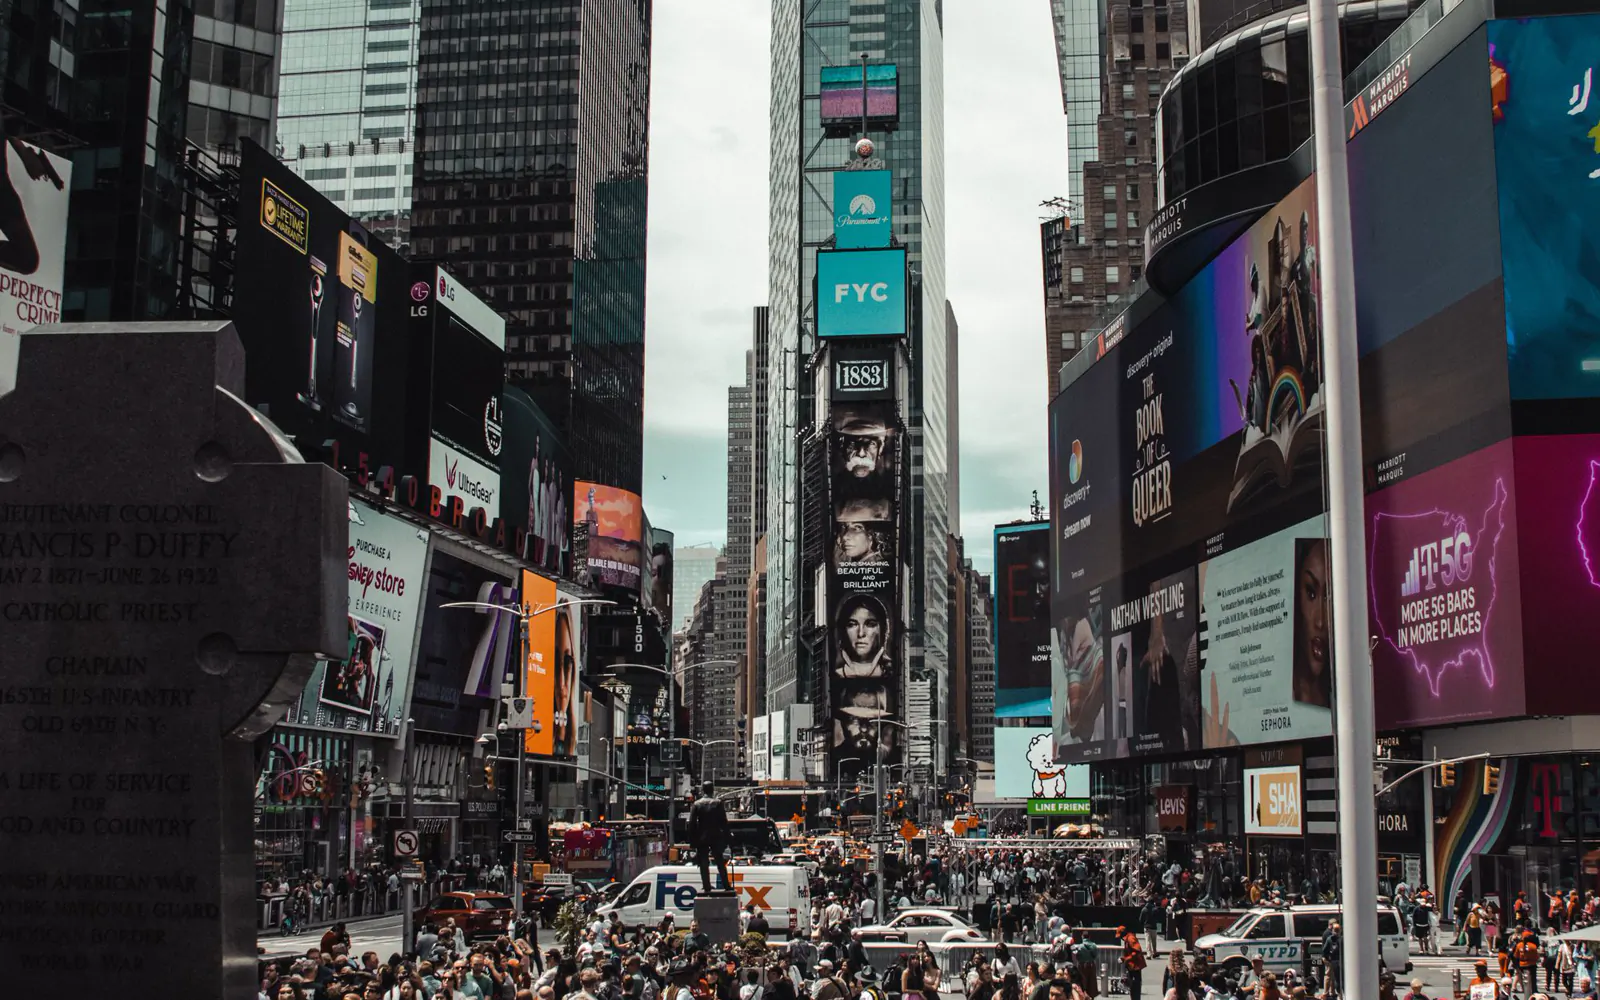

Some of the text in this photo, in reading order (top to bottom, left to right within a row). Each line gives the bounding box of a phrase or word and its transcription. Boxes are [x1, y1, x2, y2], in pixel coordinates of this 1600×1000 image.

[1370, 53, 1411, 99] MARRIOTT
[1371, 75, 1408, 116] MARQUIS
[276, 204, 304, 235] LIFETIME
[1150, 198, 1187, 233] MARRIOTT
[1150, 218, 1182, 247] MARQUIS
[0, 273, 61, 311] PERFECT
[446, 284, 455, 301] LG
[835, 282, 888, 303] FYC
[410, 305, 428, 317] LG
[842, 365, 881, 387] 1883
[1142, 372, 1154, 400] THE
[1136, 393, 1164, 451] BOOK
[1146, 441, 1154, 465] OF
[1377, 452, 1406, 472] MARRIOTT
[1378, 467, 1404, 484] MARQUIS
[458, 471, 492, 504] UltraGear
[1063, 480, 1090, 510] discovery+
[1132, 460, 1172, 527] QUEER
[0, 503, 219, 524] IEUTENANT COLONEL
[1064, 514, 1092, 540] stream now
[135, 532, 239, 558] DUFFY
[1206, 532, 1224, 545] MARRIOTT
[1207, 544, 1223, 555] MARQUIS
[356, 539, 391, 561] PURCHASE A
[1440, 531, 1473, 587] 5G
[32, 568, 42, 584] 2
[150, 568, 171, 584] 26
[374, 567, 405, 597] store
[837, 567, 884, 575] BEAUTIFUL
[4, 602, 200, 623] CATHOLIC PRIEST
[356, 599, 401, 622] EXPERIENCE
[1111, 582, 1184, 631] NATHAN WESTLING
[1401, 587, 1475, 625] MORE 5G BARS
[634, 616, 643, 652] 1500
[1397, 610, 1481, 648] IN MORE PLACES
[46, 656, 149, 676] CHAPLAIN
[22, 716, 64, 733] OLD
[1261, 716, 1291, 732] SEPHORA
[1376, 737, 1400, 747] EPHORA
[19, 772, 61, 790] LIFE
[68, 773, 98, 790] OF
[105, 772, 192, 791] SERVICE
[1035, 803, 1057, 811] LINE
[1269, 782, 1297, 814] SHA
[0, 817, 196, 838] OD AND COUNTRY
[153, 873, 197, 892] WAR
[151, 902, 220, 918] GUARD
[1257, 946, 1298, 958] NYPD
